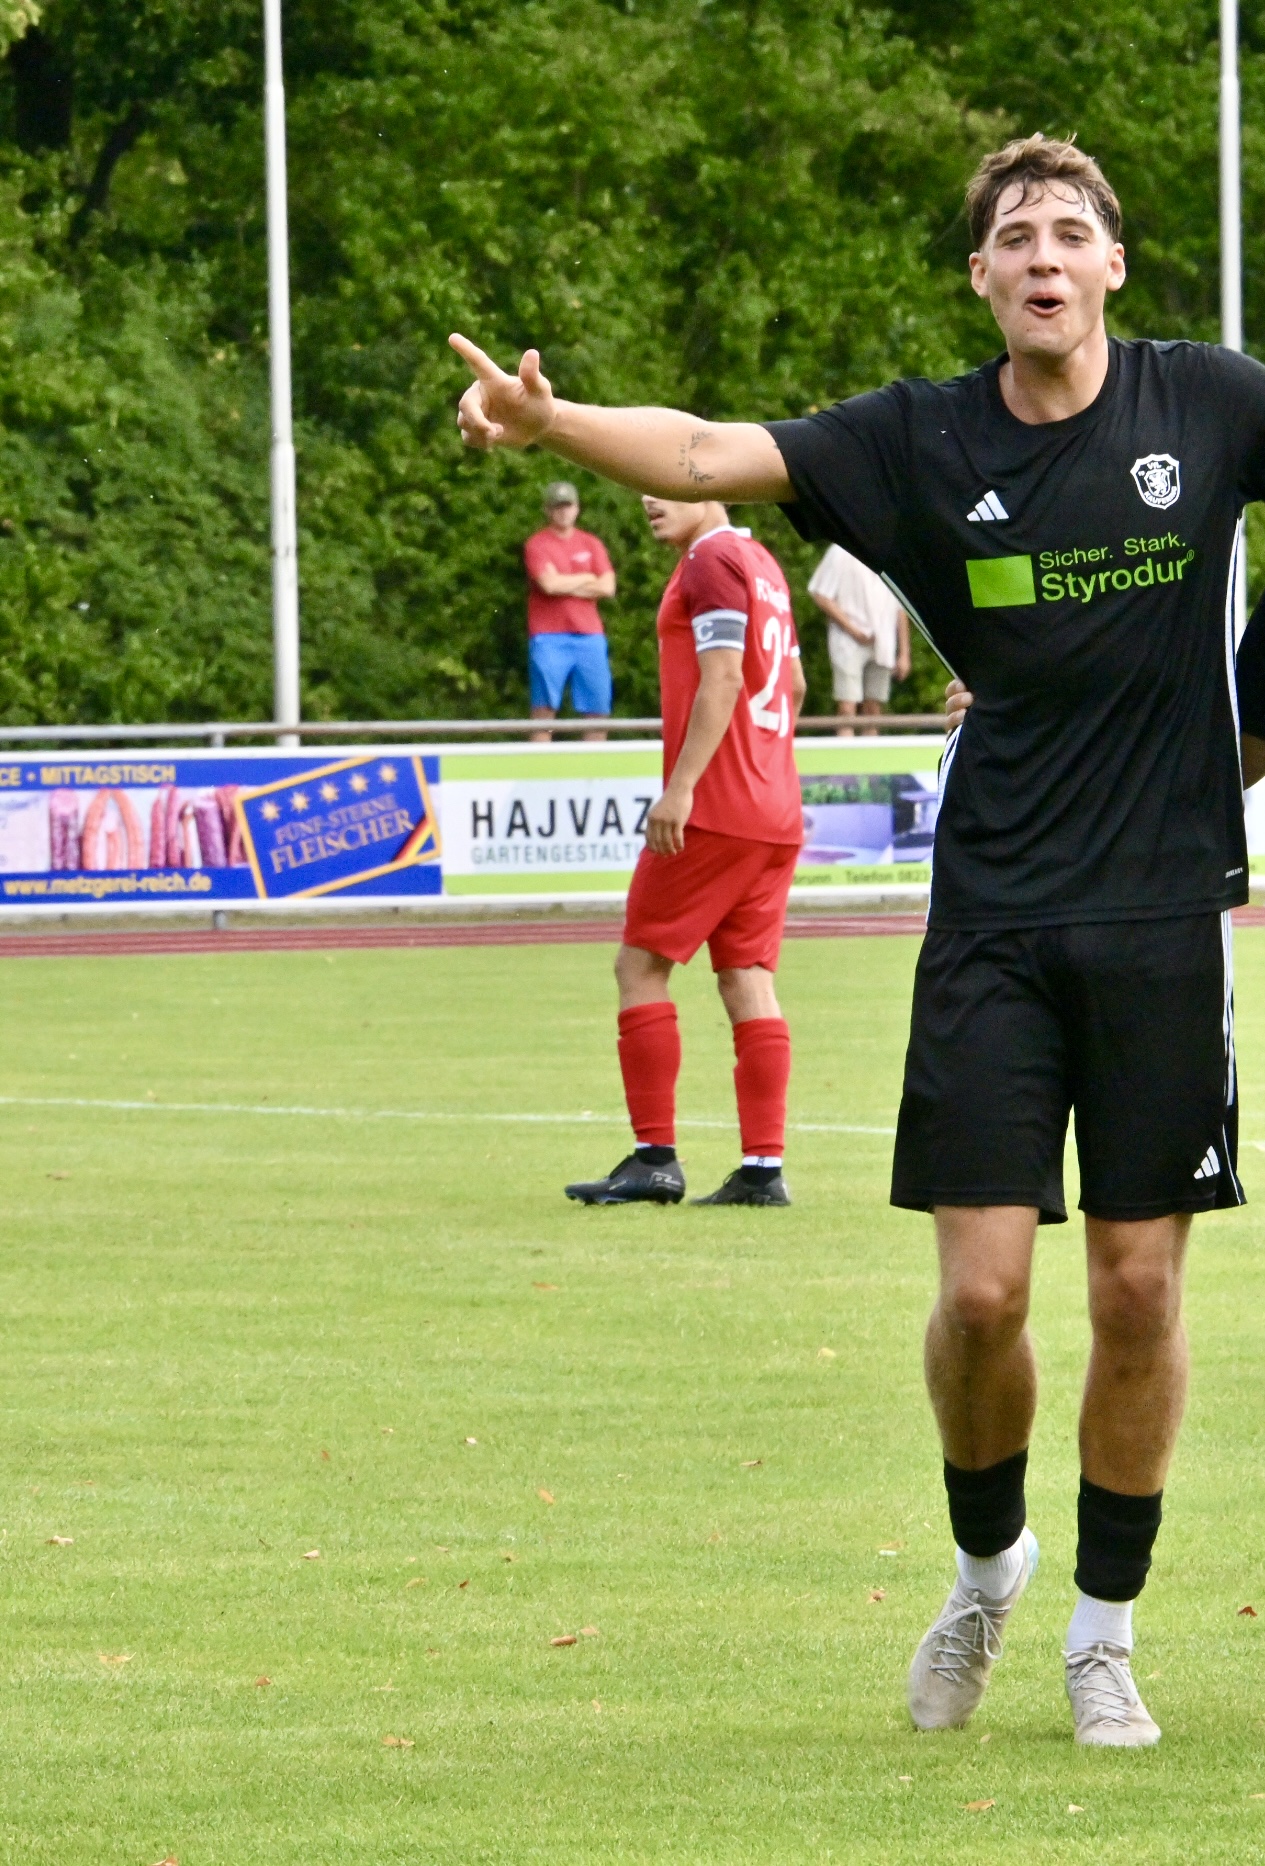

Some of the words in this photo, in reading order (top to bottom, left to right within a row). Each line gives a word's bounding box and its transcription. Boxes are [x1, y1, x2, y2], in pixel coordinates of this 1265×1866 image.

[1039, 546, 1114, 569] Sicher.
[1123, 531, 1187, 556] Stark.
[696, 621, 714, 642] C
[40, 765, 176, 785] MITTAGSTISCH
[270, 808, 415, 874] FLEISCHER
[3, 872, 212, 898] www.metzgerei-reich.de
[846, 868, 894, 883] Telefon
